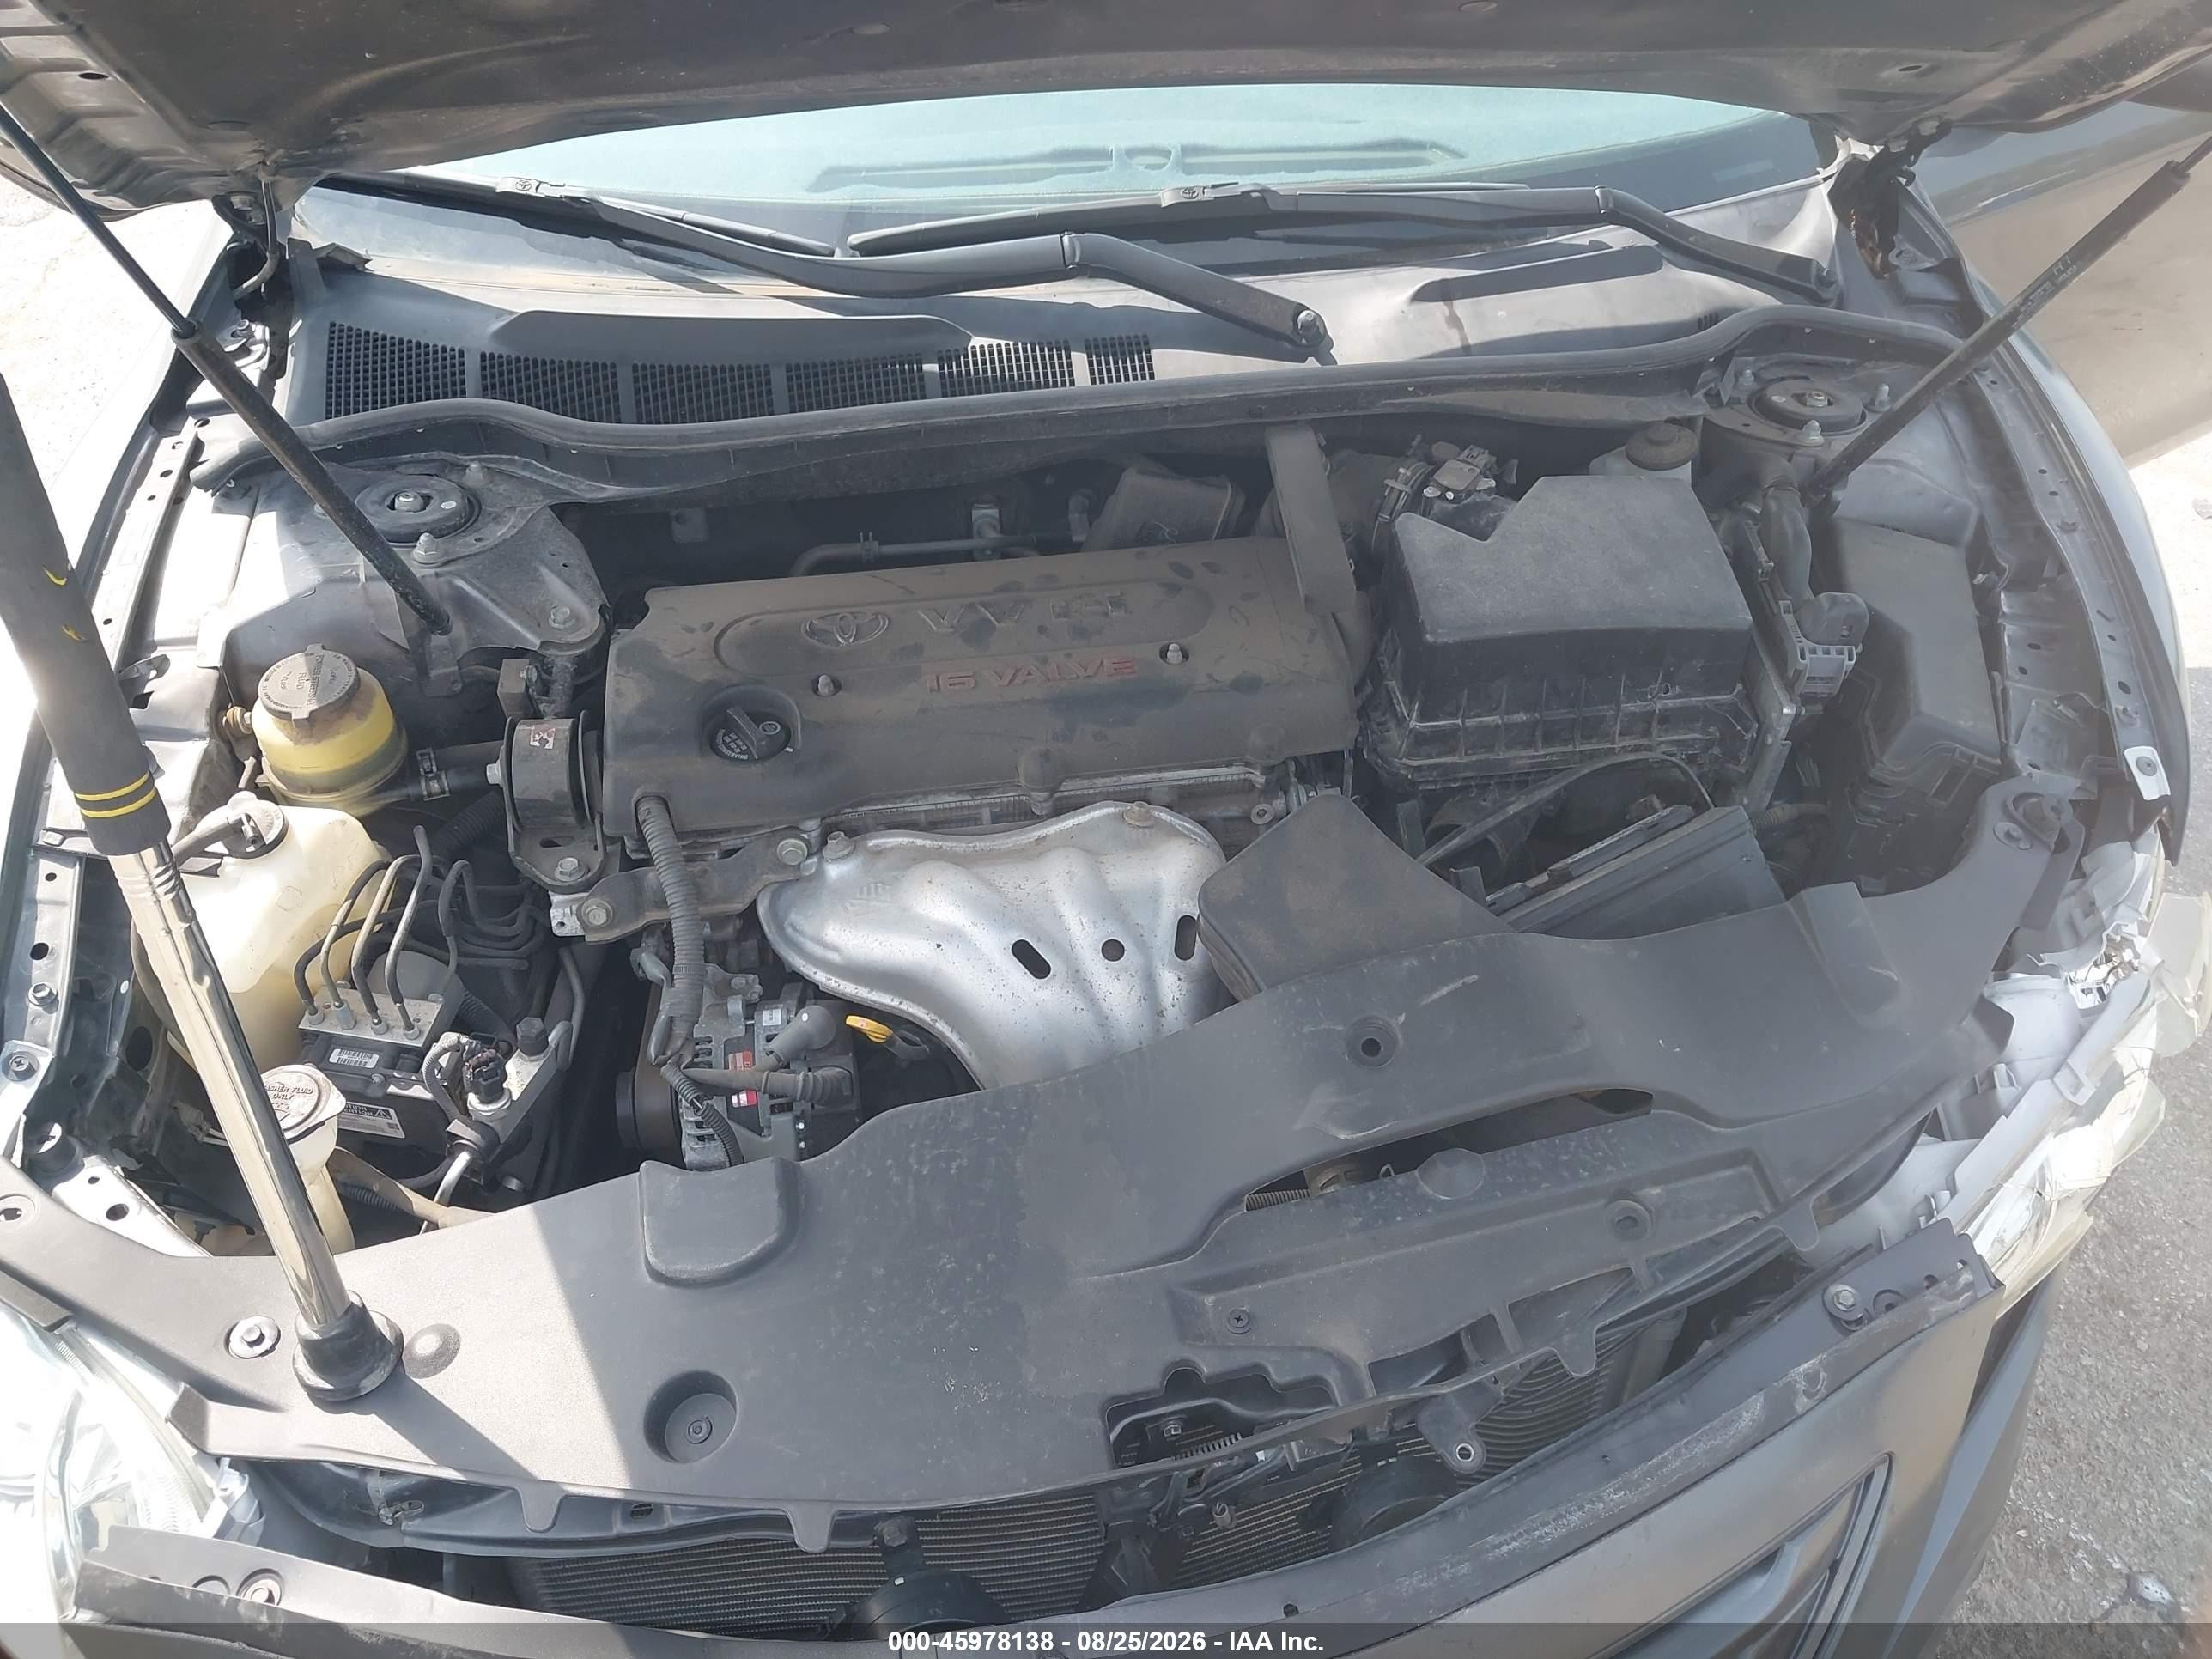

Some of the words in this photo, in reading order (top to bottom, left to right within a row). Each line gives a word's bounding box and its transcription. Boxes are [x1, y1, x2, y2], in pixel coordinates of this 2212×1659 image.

[295, 672, 307, 690] FLUID
[926, 672, 976, 693] 16
[988, 658, 1138, 686] VALVE
[265, 1084, 290, 1093] ASHER
[291, 1086, 314, 1095] FLUID
